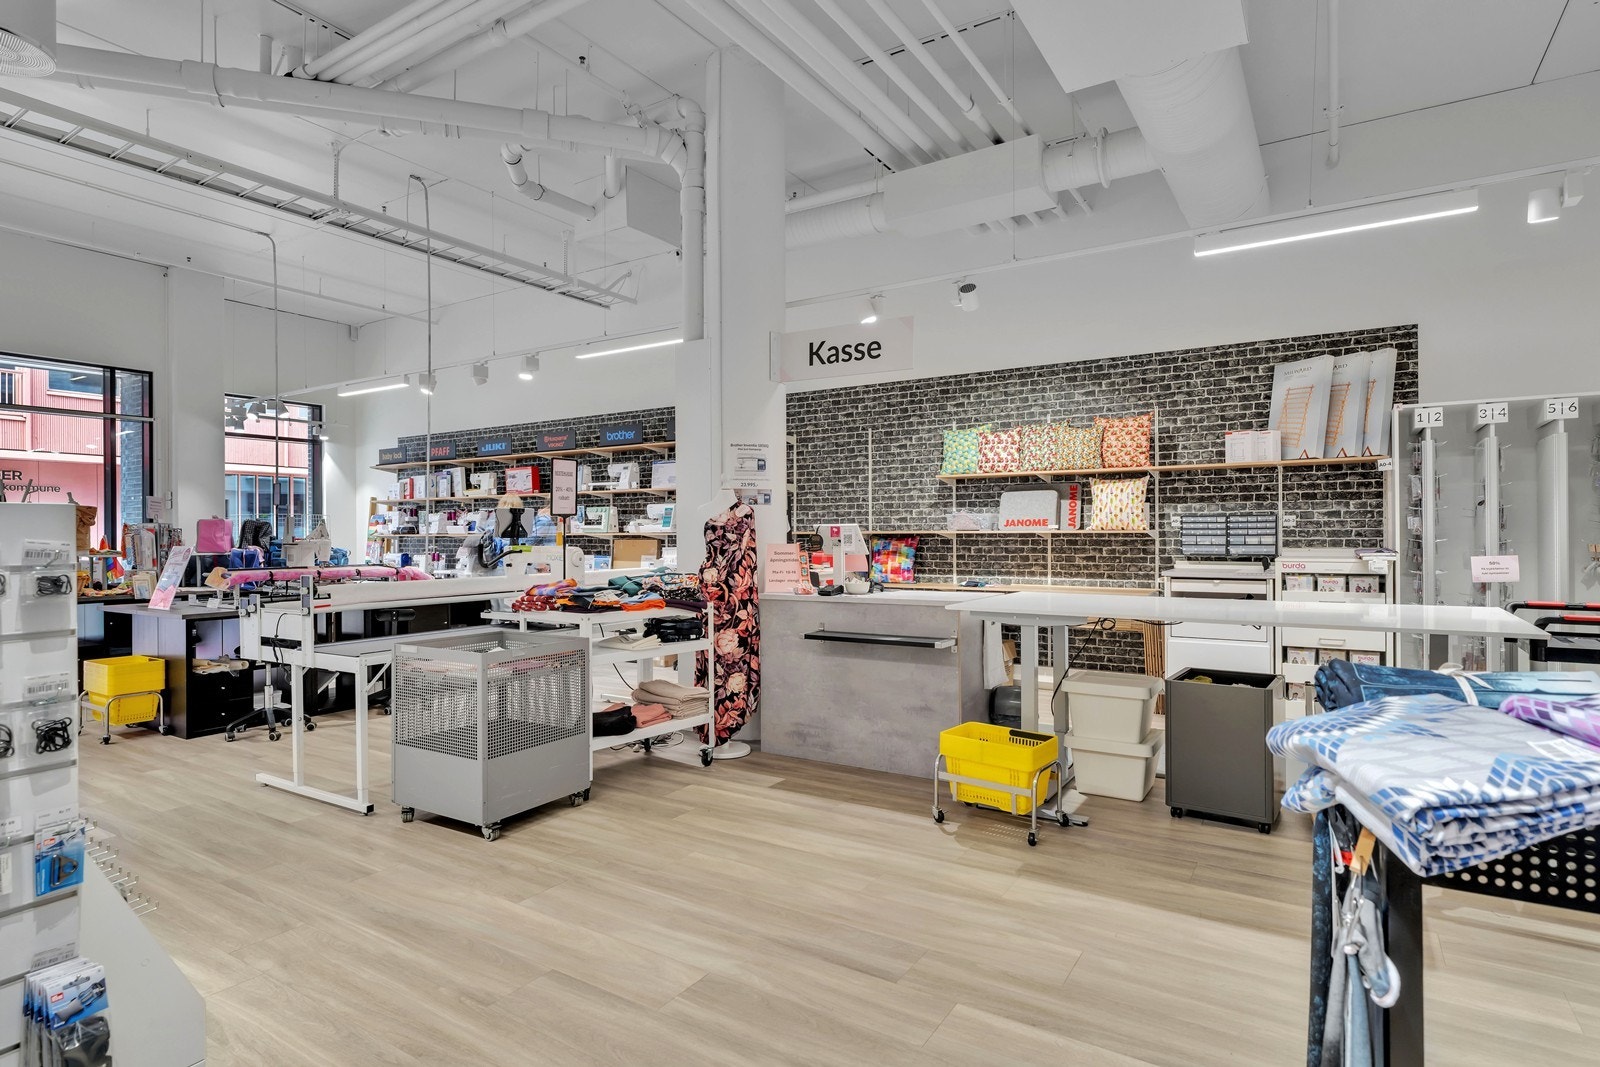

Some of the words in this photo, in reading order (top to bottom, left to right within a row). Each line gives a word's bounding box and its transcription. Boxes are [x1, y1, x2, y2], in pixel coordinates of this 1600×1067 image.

[809, 341, 882, 366] Kasse
[606, 430, 635, 441] brother
[431, 446, 450, 457] PFAFF
[481, 442, 507, 452] JUKI
[1067, 484, 1078, 530] JANOME
[1003, 518, 1049, 528] JANOME
[1282, 562, 1306, 570] burda
